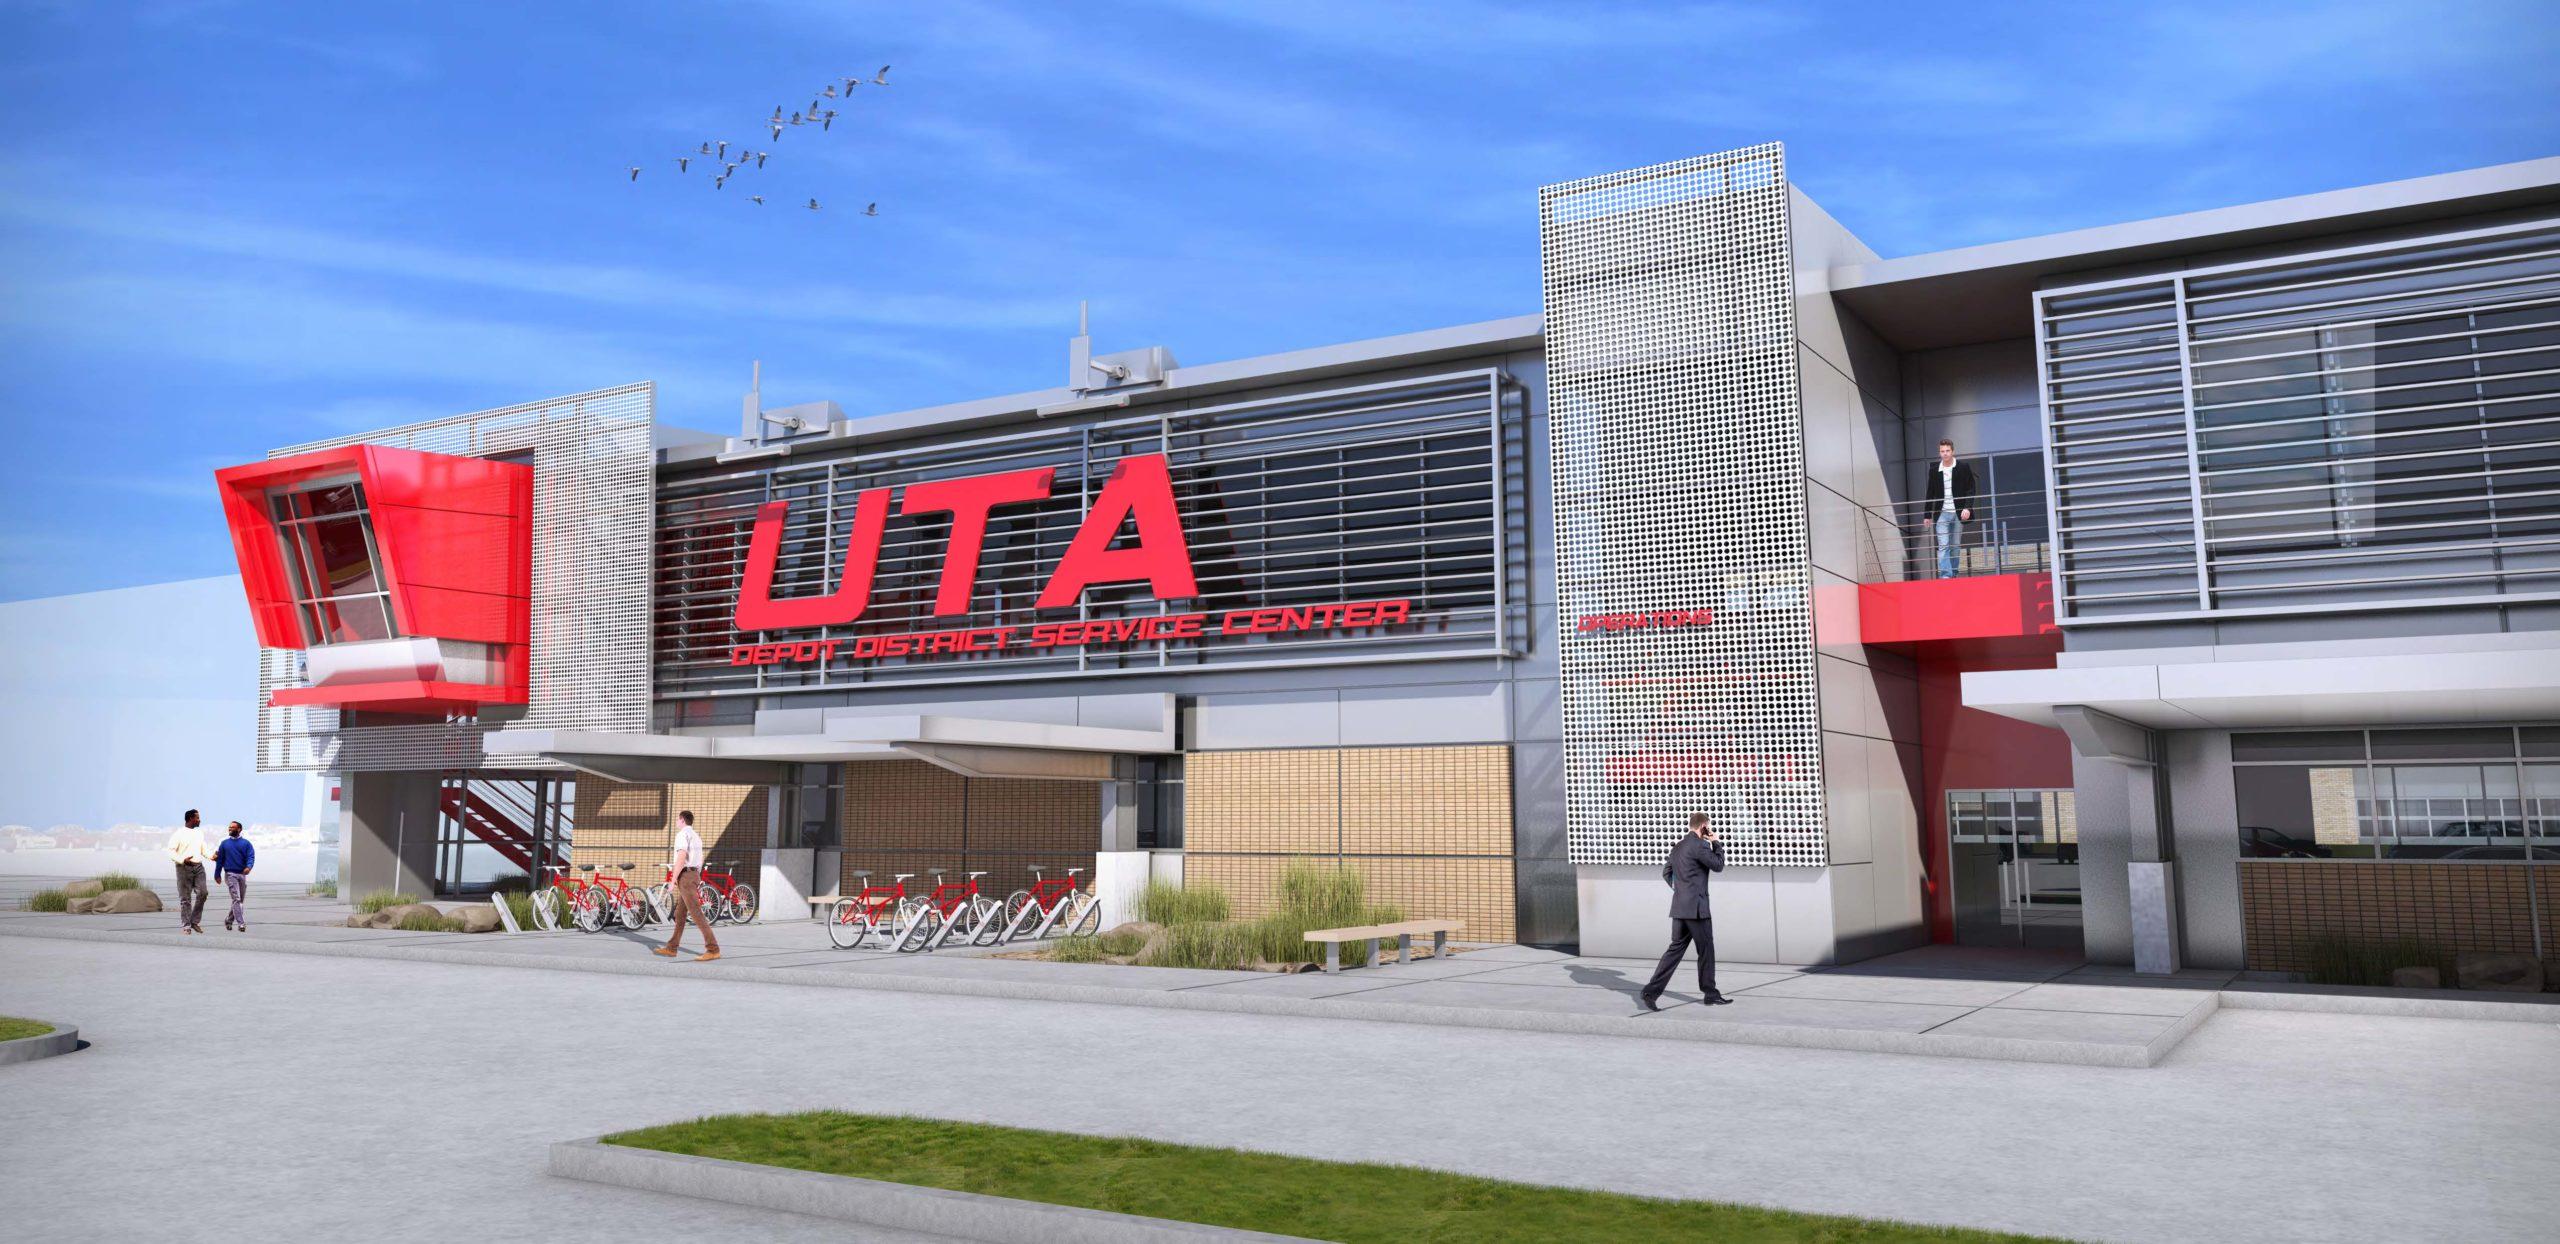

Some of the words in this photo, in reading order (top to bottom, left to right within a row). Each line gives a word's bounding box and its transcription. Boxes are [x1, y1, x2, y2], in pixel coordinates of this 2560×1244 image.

[733, 454, 1199, 631] UTA
[731, 639, 842, 666] DEPOT
[853, 627, 1017, 658] DISTRICT
[1030, 614, 1205, 647] SERVICE
[1222, 600, 1410, 634] CENTER
[1577, 609, 1713, 632] OPERATIONS
